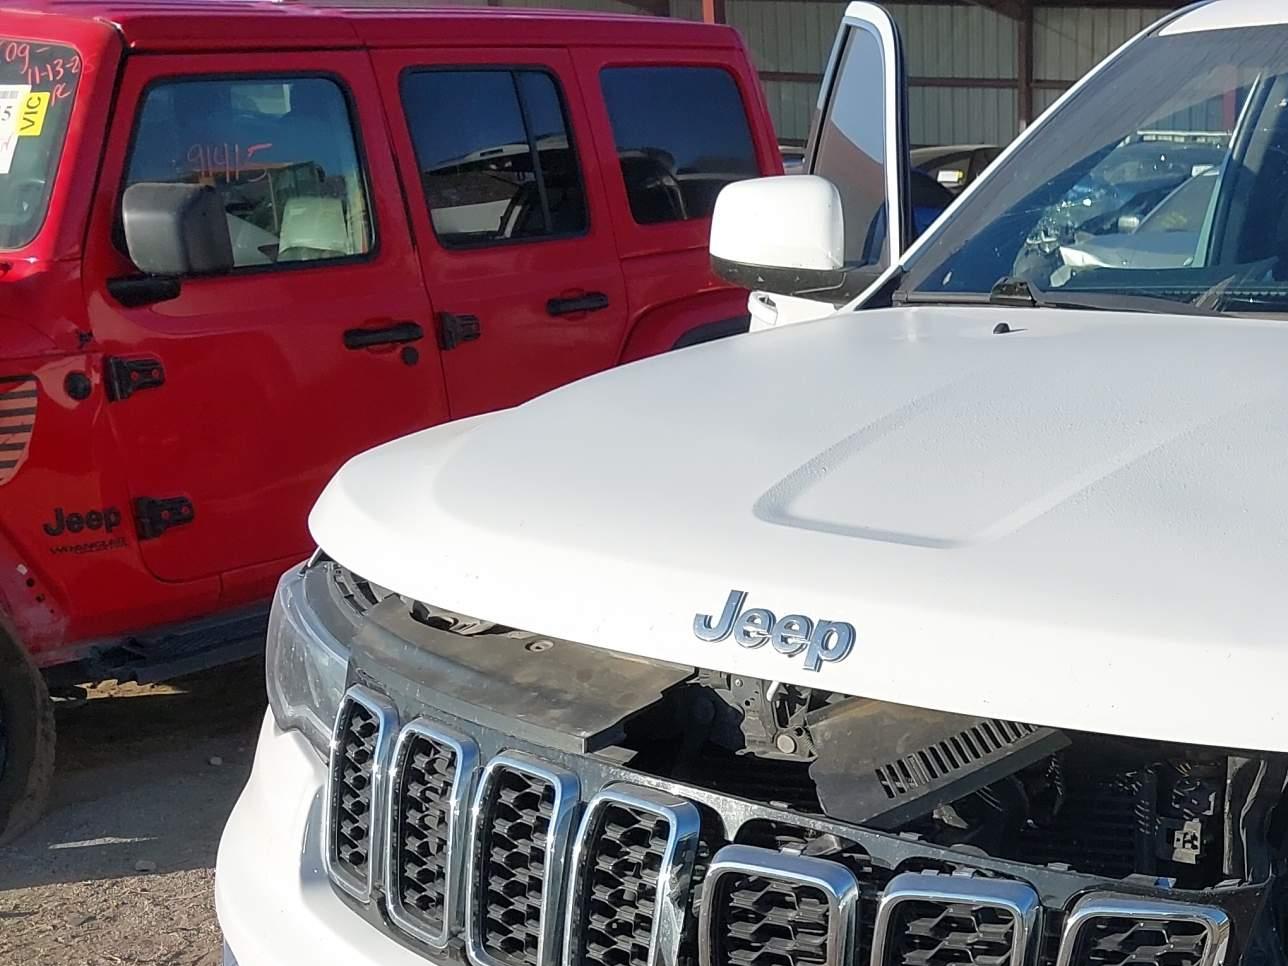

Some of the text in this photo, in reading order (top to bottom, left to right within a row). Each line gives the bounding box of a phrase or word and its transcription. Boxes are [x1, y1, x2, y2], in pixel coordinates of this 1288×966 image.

[20, 96, 41, 132] VIC
[43, 507, 122, 536] Jeep
[693, 589, 857, 673] Jeep
